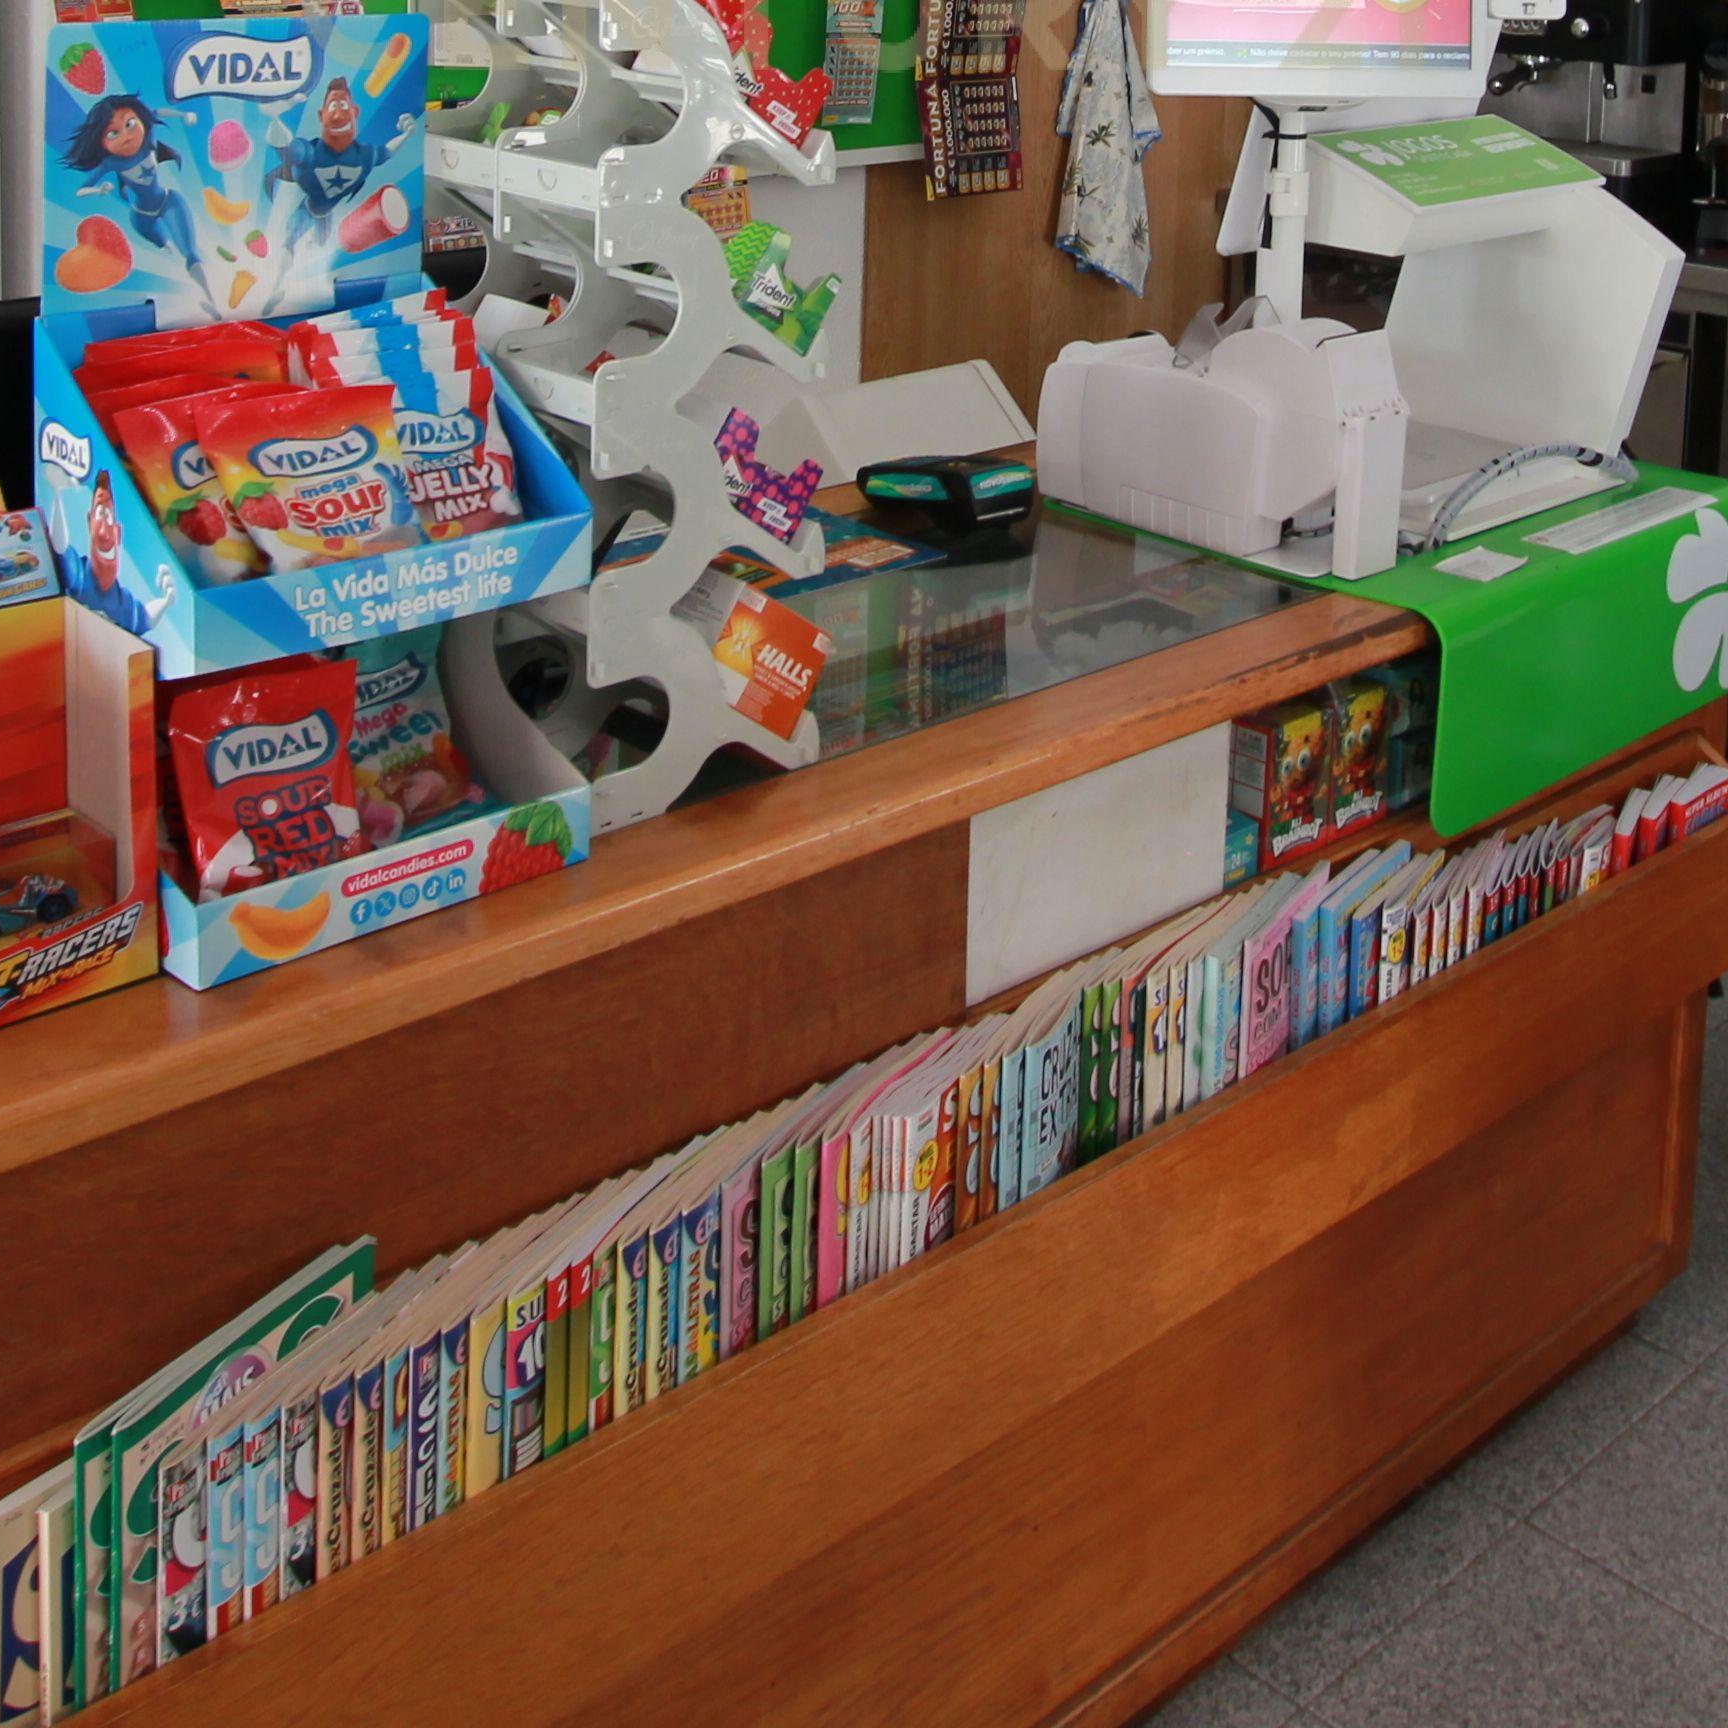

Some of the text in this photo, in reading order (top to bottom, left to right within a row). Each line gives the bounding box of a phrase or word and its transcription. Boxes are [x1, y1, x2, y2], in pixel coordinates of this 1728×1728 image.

[189, 49, 302, 86] VIDAL
[923, 78, 948, 193] FORTUNA
[751, 272, 795, 311] Trident
[44, 433, 88, 471] VIDAL
[396, 415, 471, 451] VIDAL
[268, 436, 358, 475] VIDAL
[288, 481, 385, 529] sour
[299, 473, 359, 502] mega
[408, 463, 493, 506] JELLY
[321, 514, 374, 542] mix
[434, 493, 490, 524] MIX
[297, 540, 518, 612] La Vida Más Dulce
[306, 571, 513, 639] The Sweetest life
[757, 642, 813, 688] HALLS
[354, 703, 407, 738] Mega
[222, 729, 323, 771] VIDAL
[236, 777, 333, 825] SOUR
[247, 808, 336, 858] RED
[347, 842, 468, 894] vidalcandies.com
